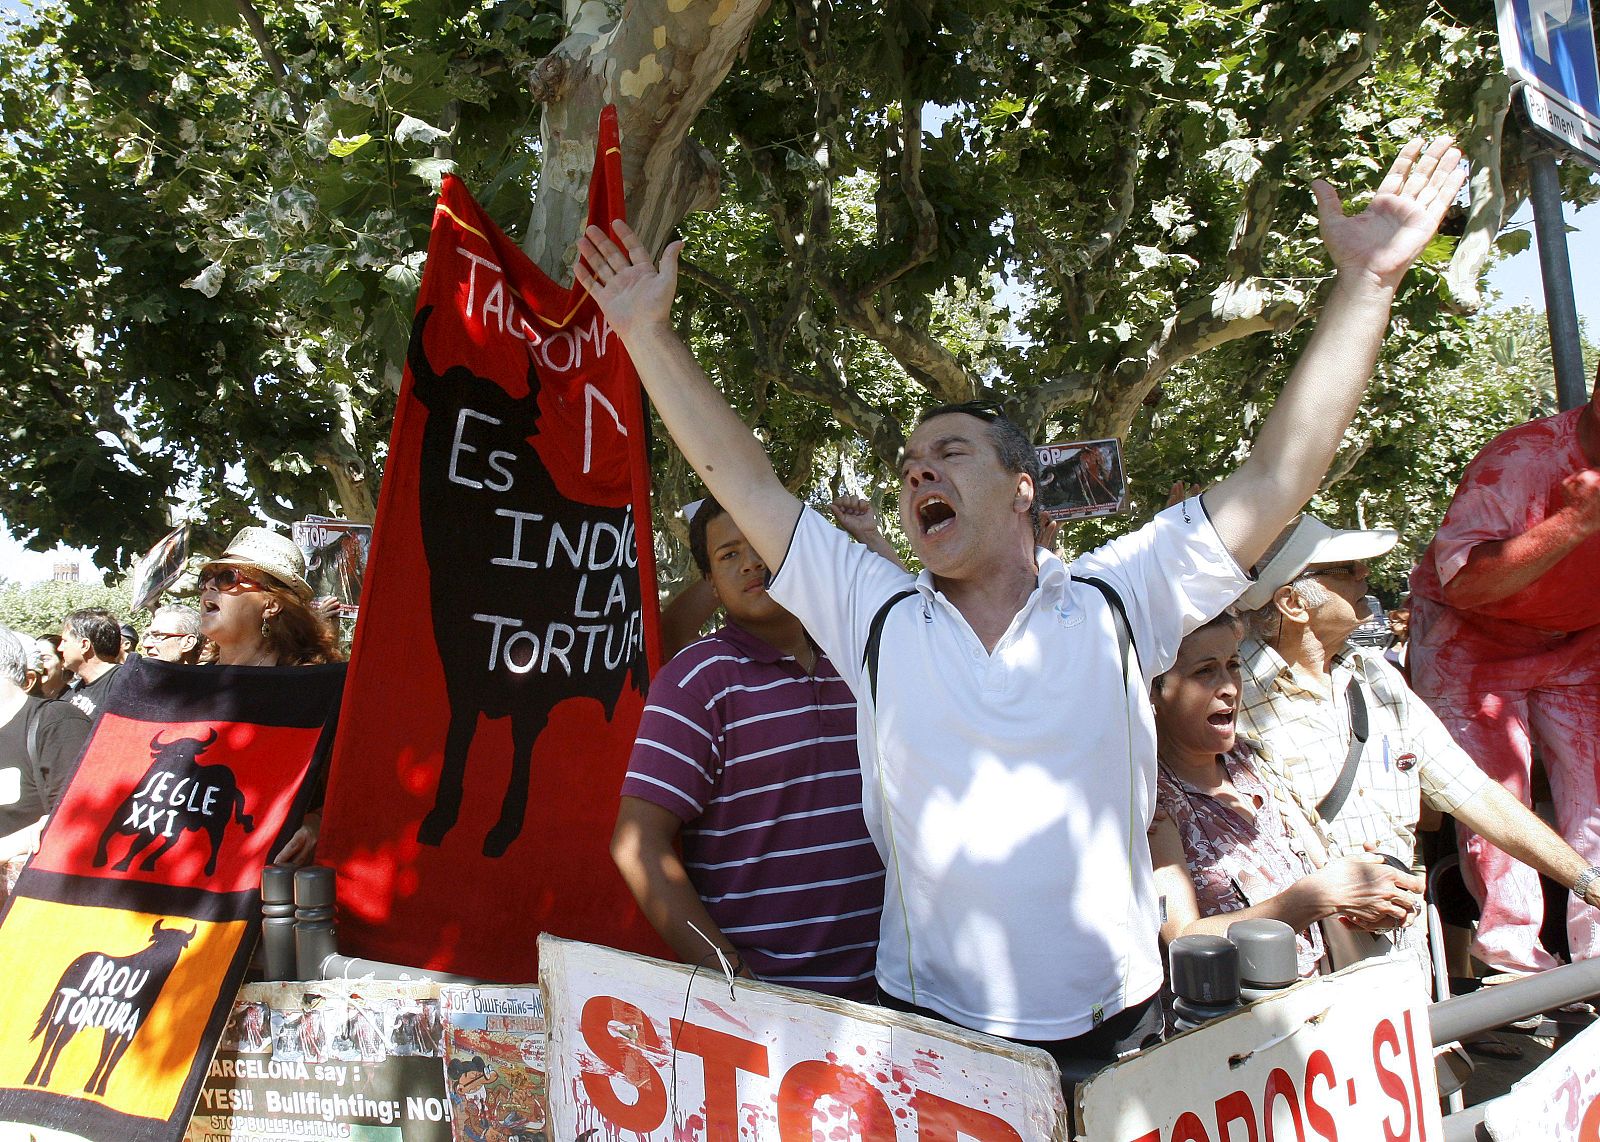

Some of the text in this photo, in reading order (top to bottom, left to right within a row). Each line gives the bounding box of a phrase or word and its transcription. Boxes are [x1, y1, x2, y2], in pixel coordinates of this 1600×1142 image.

[1529, 93, 1577, 139] Parlament
[449, 408, 517, 491] Es
[295, 527, 327, 547] STOP
[574, 573, 626, 618] LA
[133, 771, 220, 816] SEGLE
[122, 800, 180, 838] XXI
[79, 955, 150, 1000] PROU
[53, 987, 141, 1041] TORTURA
[208, 1059, 309, 1080] ARCELONA
[314, 1065, 347, 1086] say
[202, 1088, 451, 1124] YES!! Bullfighting: NO!
[211, 1115, 350, 1137] STOP BULLFIGHTING
